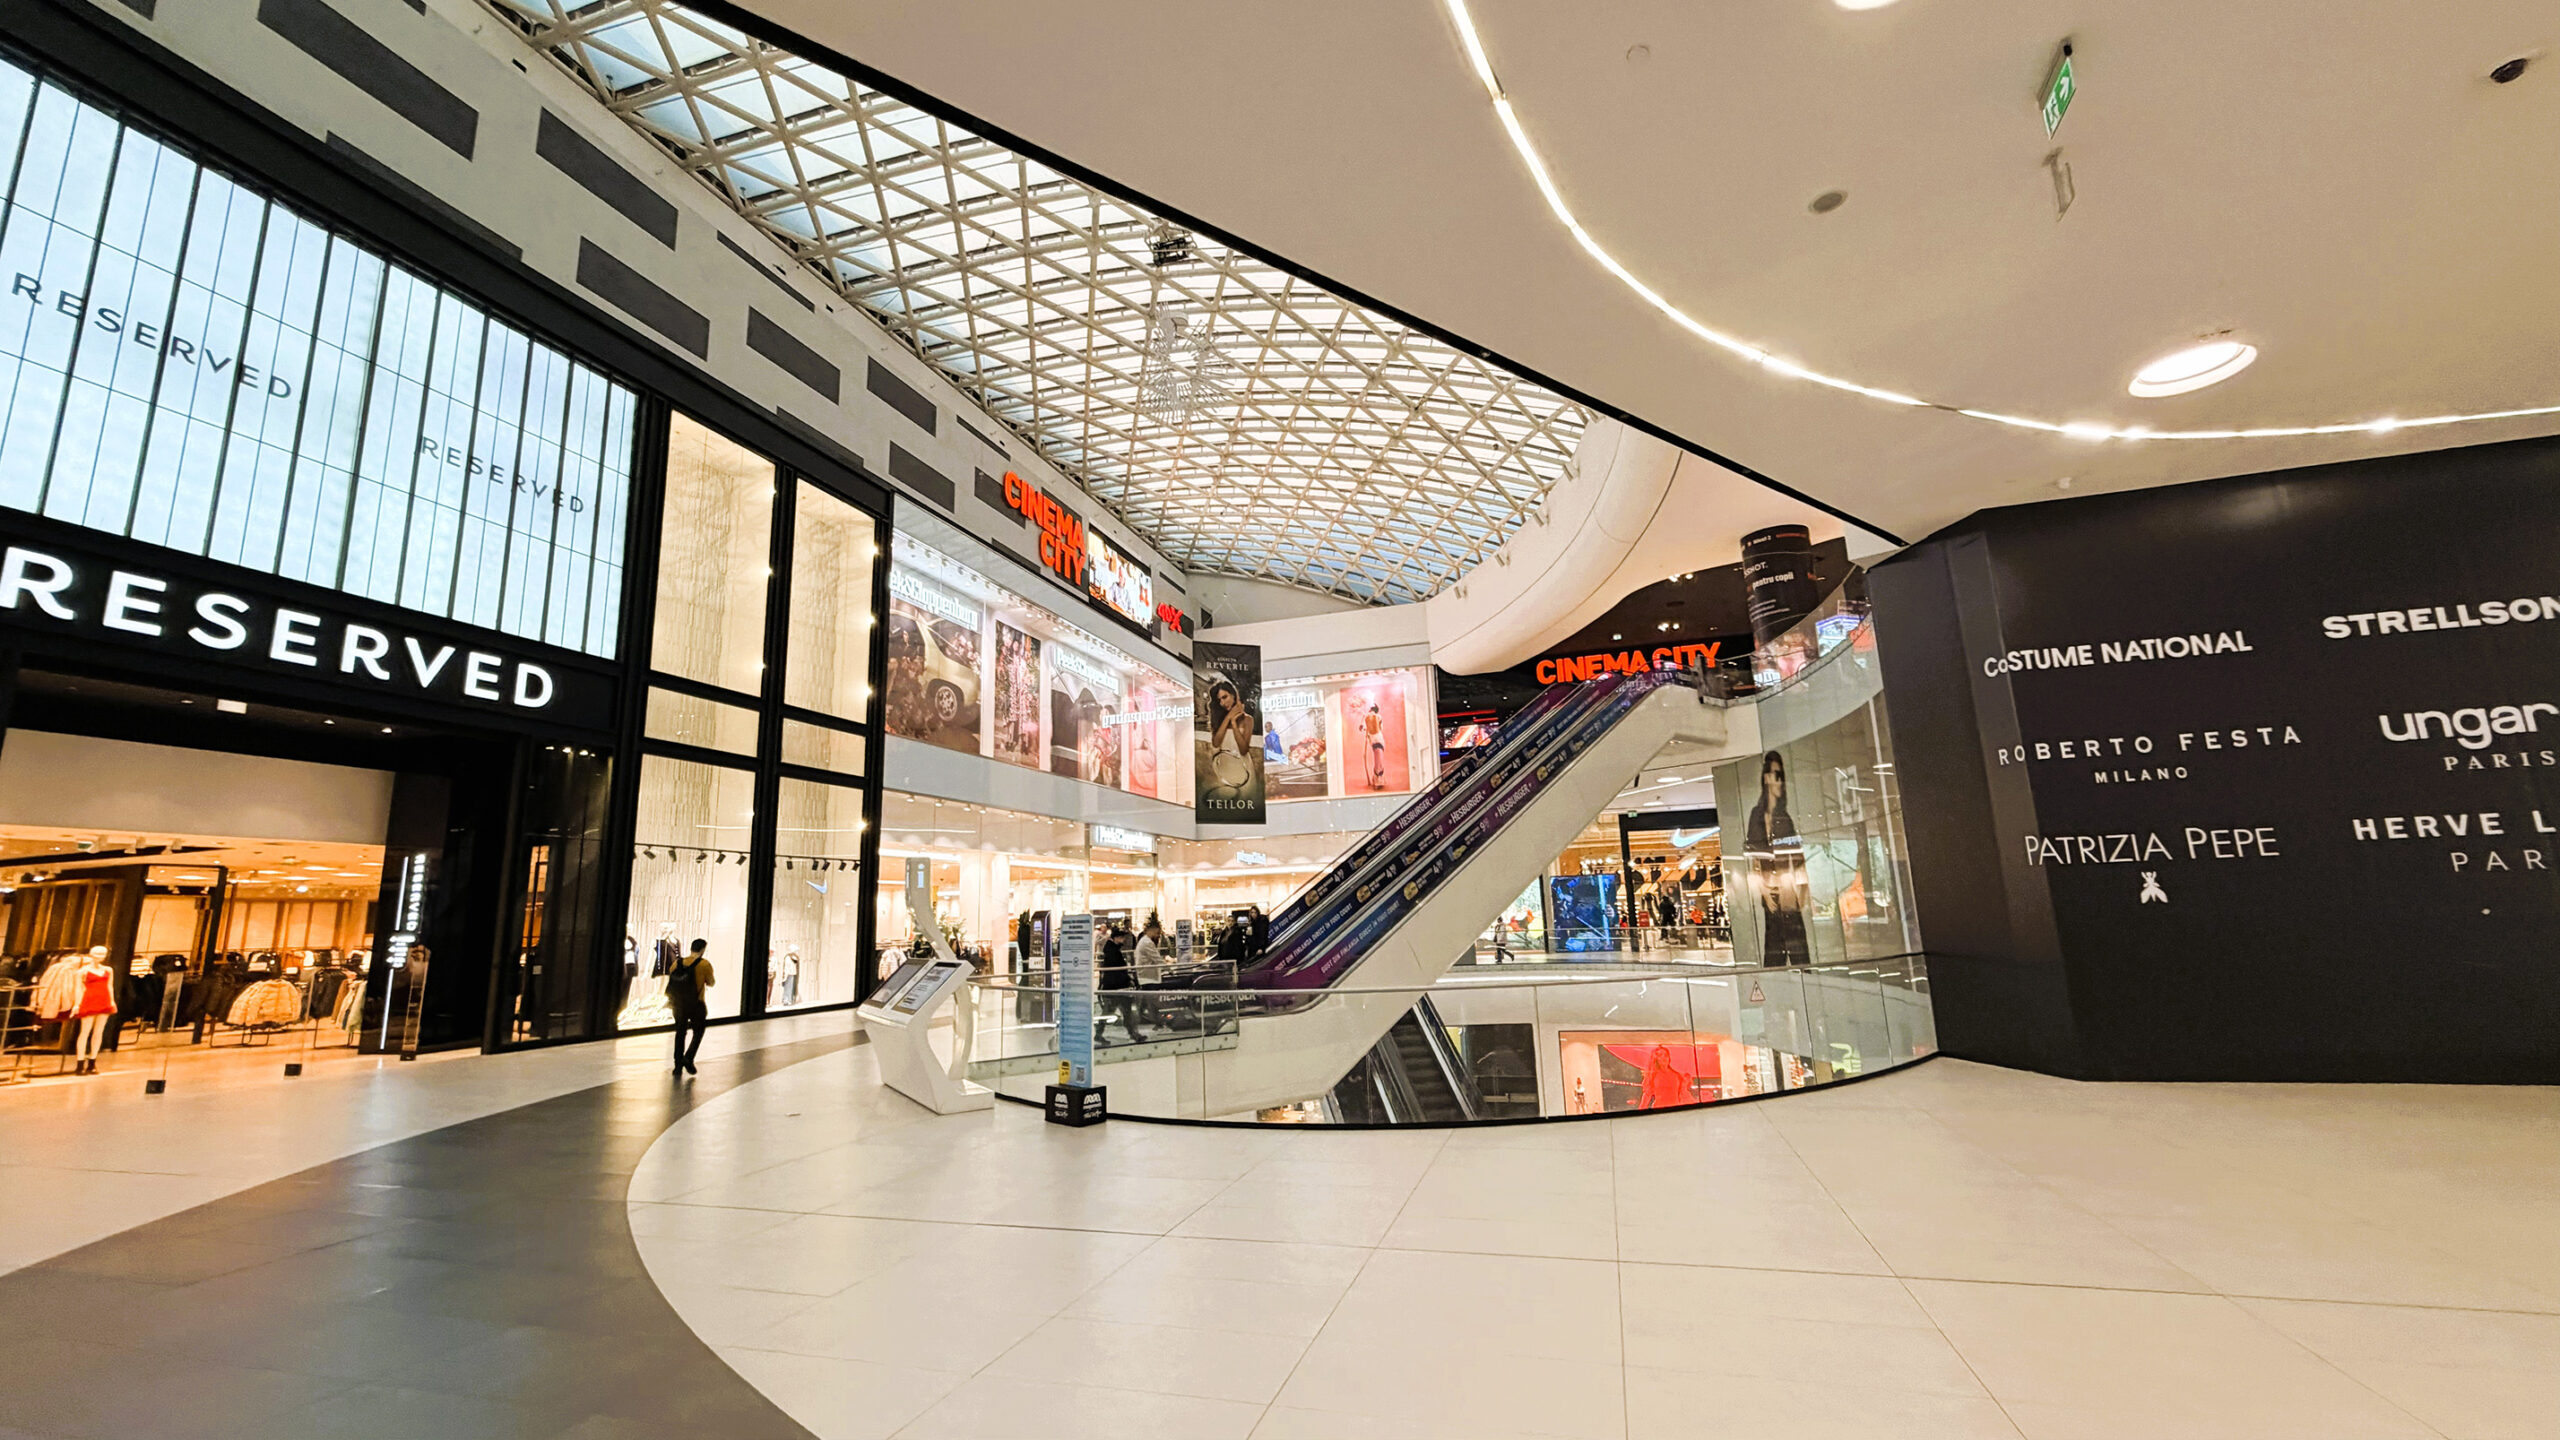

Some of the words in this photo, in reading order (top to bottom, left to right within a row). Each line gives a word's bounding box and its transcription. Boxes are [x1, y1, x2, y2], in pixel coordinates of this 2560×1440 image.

[12, 273, 291, 399] RESERVED
[420, 436, 584, 513] RESERVED
[1004, 470, 1086, 558] CINEMA
[1040, 530, 1086, 586] CITY
[0, 546, 554, 709] RESERVED
[2322, 596, 2560, 639] STRELLSON
[1536, 650, 1650, 685] CINEMA
[1652, 642, 1721, 671] CITY
[2101, 630, 2253, 664] NATIONAL
[1998, 735, 2153, 766] ROBERTO
[2179, 726, 2302, 751] FESTA
[2378, 703, 2560, 750] ungar
[2094, 766, 2188, 784] MILANO
[2443, 750, 2556, 771] PARIS
[1207, 799, 1255, 810] TEILOR
[1399, 798, 1432, 829] HESBURGER
[1450, 791, 1485, 824] HESBURGER
[1496, 783, 1531, 817] HESBURGER
[2352, 812, 2505, 841] HERVE
[2024, 832, 2173, 866] PATRIZIA
[2185, 827, 2280, 859] PEPE
[2450, 849, 2548, 873] PAR
